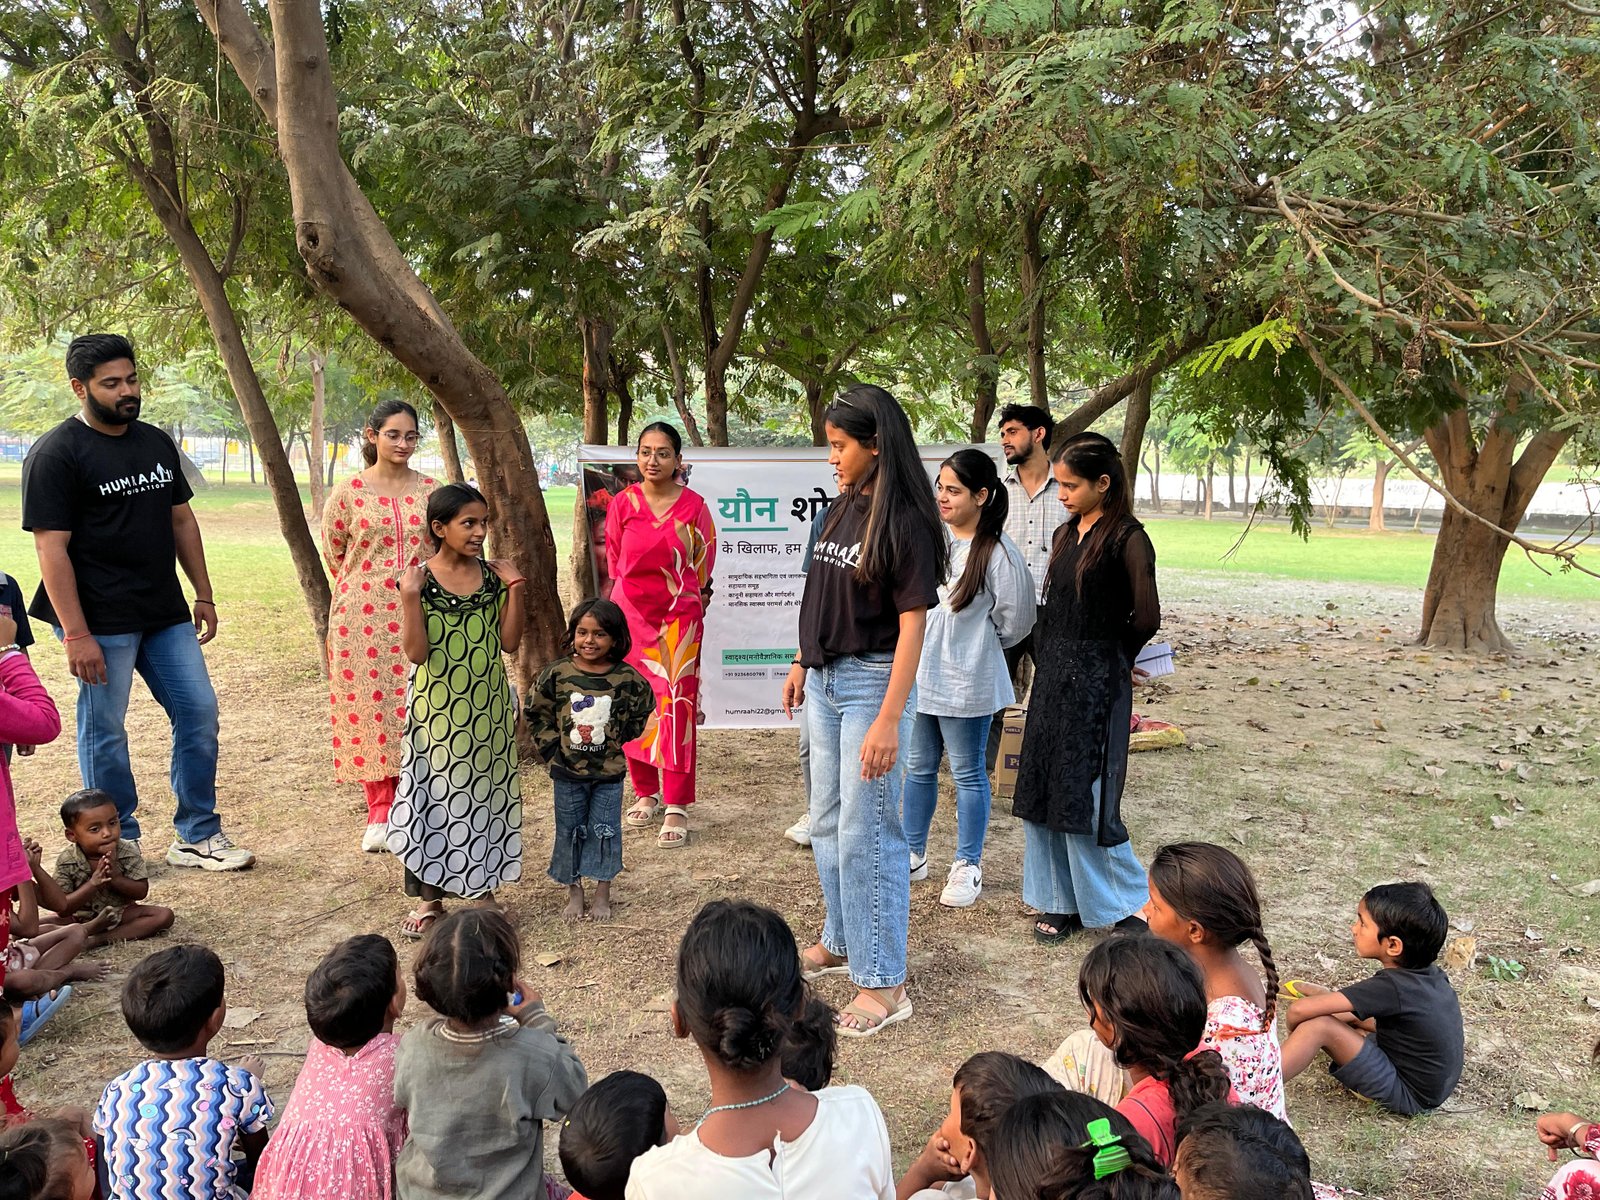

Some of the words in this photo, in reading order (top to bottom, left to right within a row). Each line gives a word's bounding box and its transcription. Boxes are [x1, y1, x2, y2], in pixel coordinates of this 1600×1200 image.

[717, 488, 779, 522] यौन
[722, 540, 733, 554] के
[737, 541, 781, 556] खिलाफ,
[785, 543, 802, 555] हम
